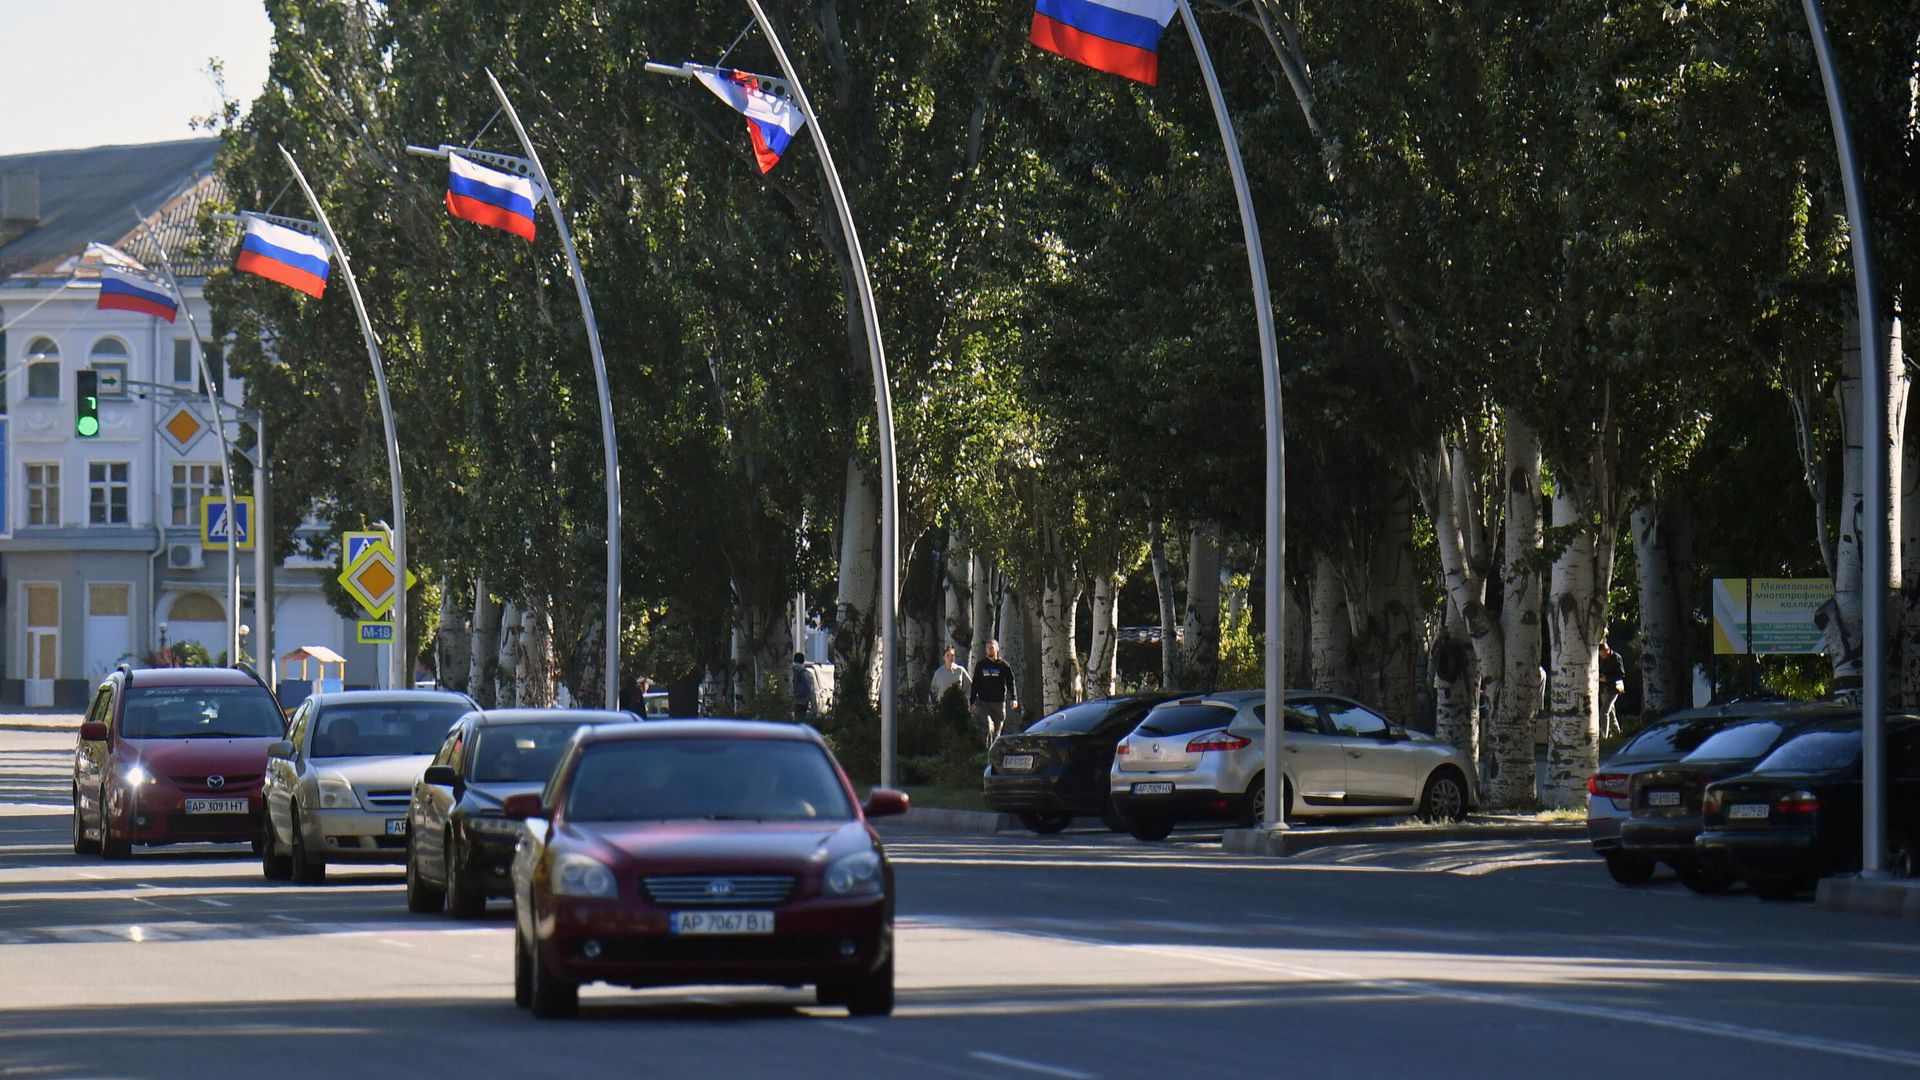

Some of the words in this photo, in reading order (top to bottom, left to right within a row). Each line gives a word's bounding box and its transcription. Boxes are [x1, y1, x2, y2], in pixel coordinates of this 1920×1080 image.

[363, 626, 391, 638] M-18
[192, 802, 206, 812] AP
[208, 801, 229, 812] 3091
[230, 801, 243, 811] HT
[681, 915, 704, 930] AP
[707, 915, 743, 930] 7067
